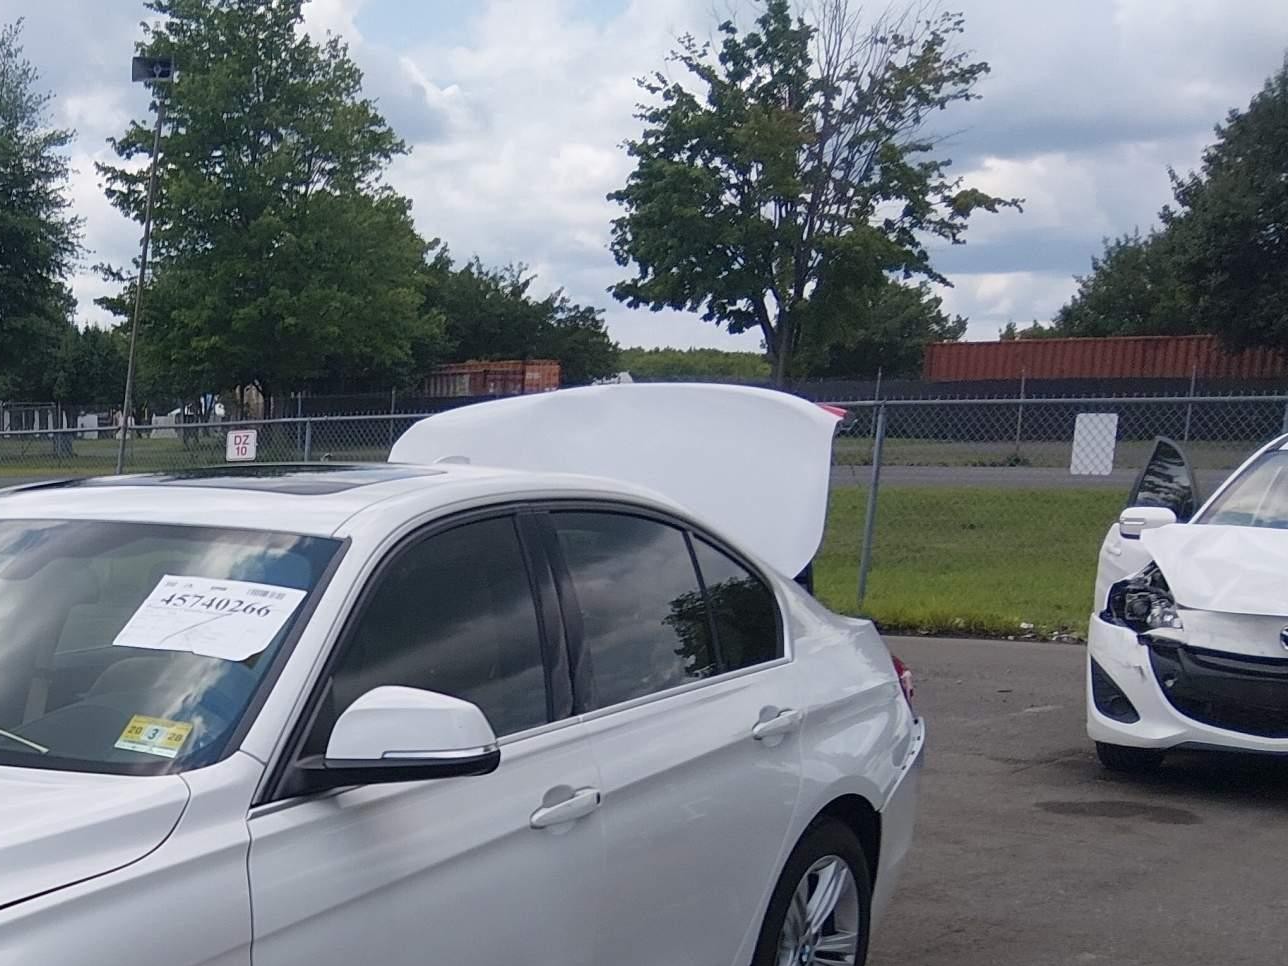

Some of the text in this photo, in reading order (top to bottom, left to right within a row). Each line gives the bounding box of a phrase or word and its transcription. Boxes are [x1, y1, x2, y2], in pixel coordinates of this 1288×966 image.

[234, 435, 250, 446] DZ
[236, 446, 247, 456] 10
[161, 593, 271, 617] 45740266
[147, 728, 160, 740] 3
